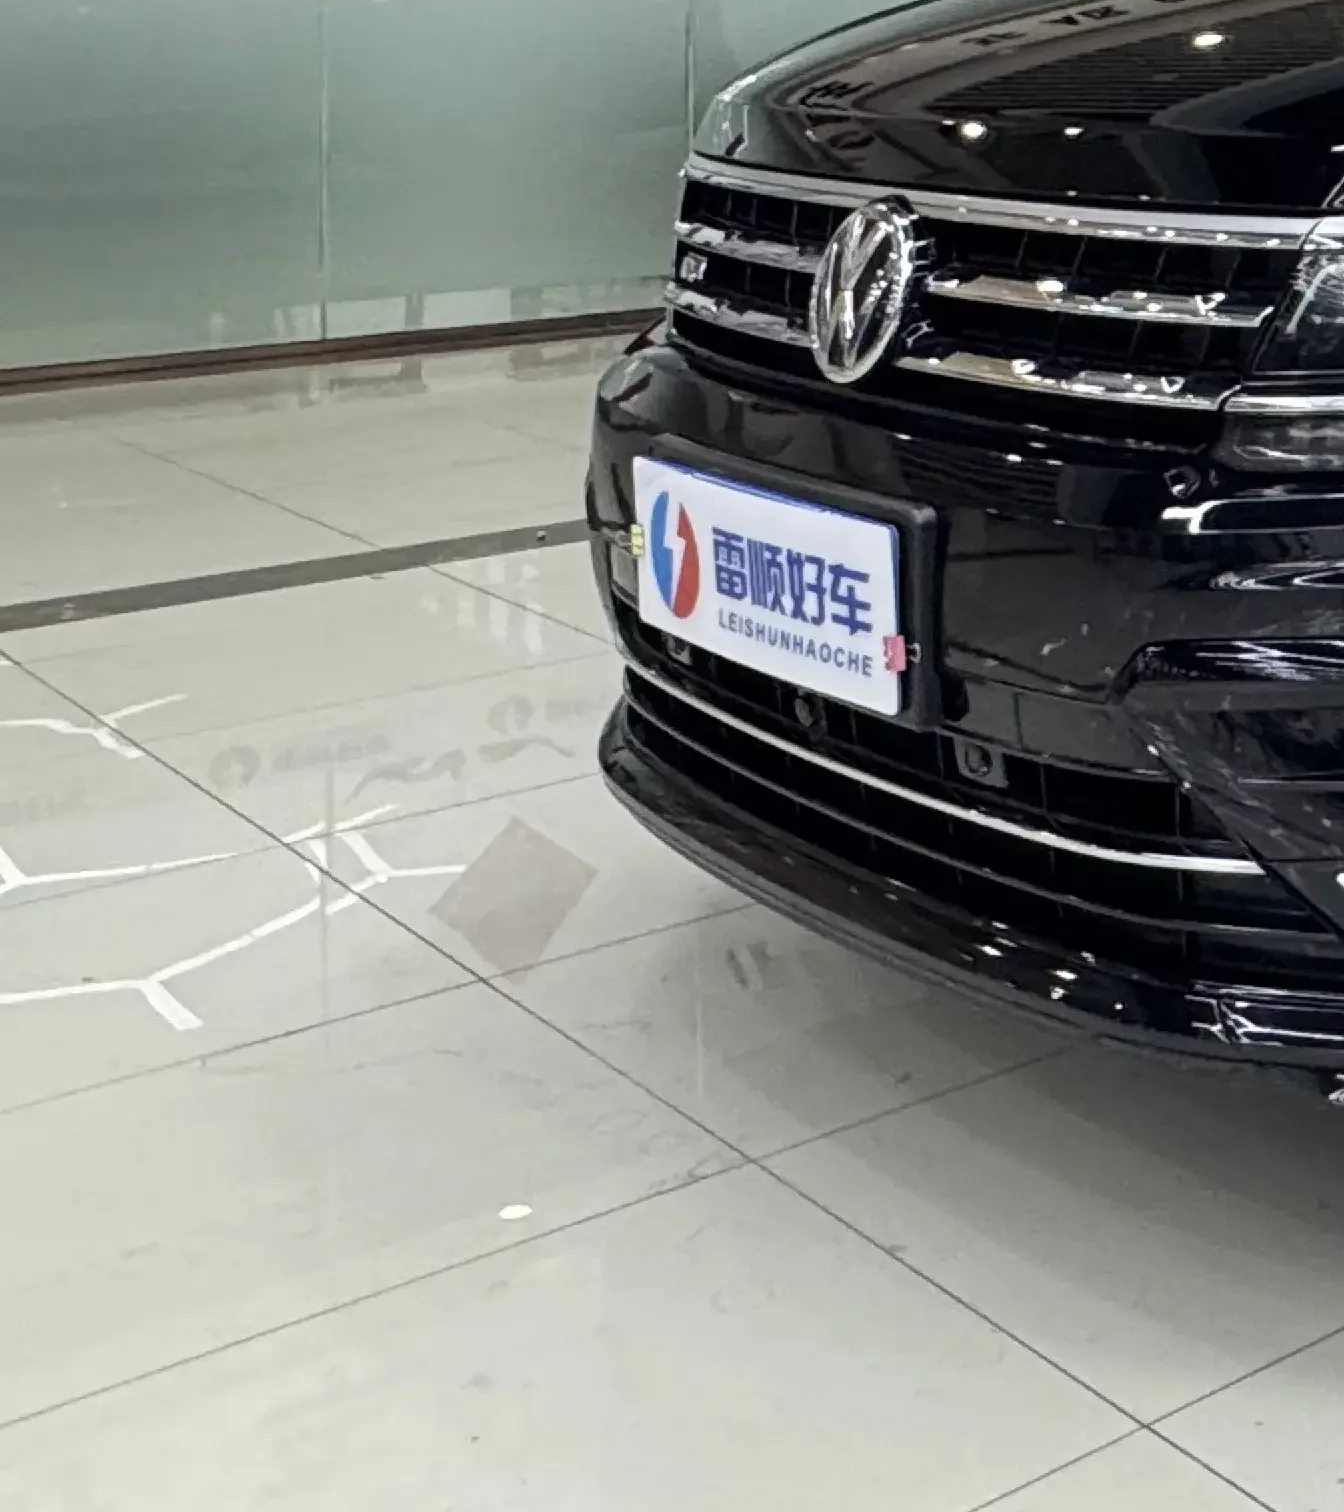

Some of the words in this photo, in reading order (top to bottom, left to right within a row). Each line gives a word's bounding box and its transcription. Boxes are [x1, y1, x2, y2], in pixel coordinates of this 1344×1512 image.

[712, 526, 873, 636] 雷顺好车
[717, 607, 873, 678] LEISHUNHAOCHE
